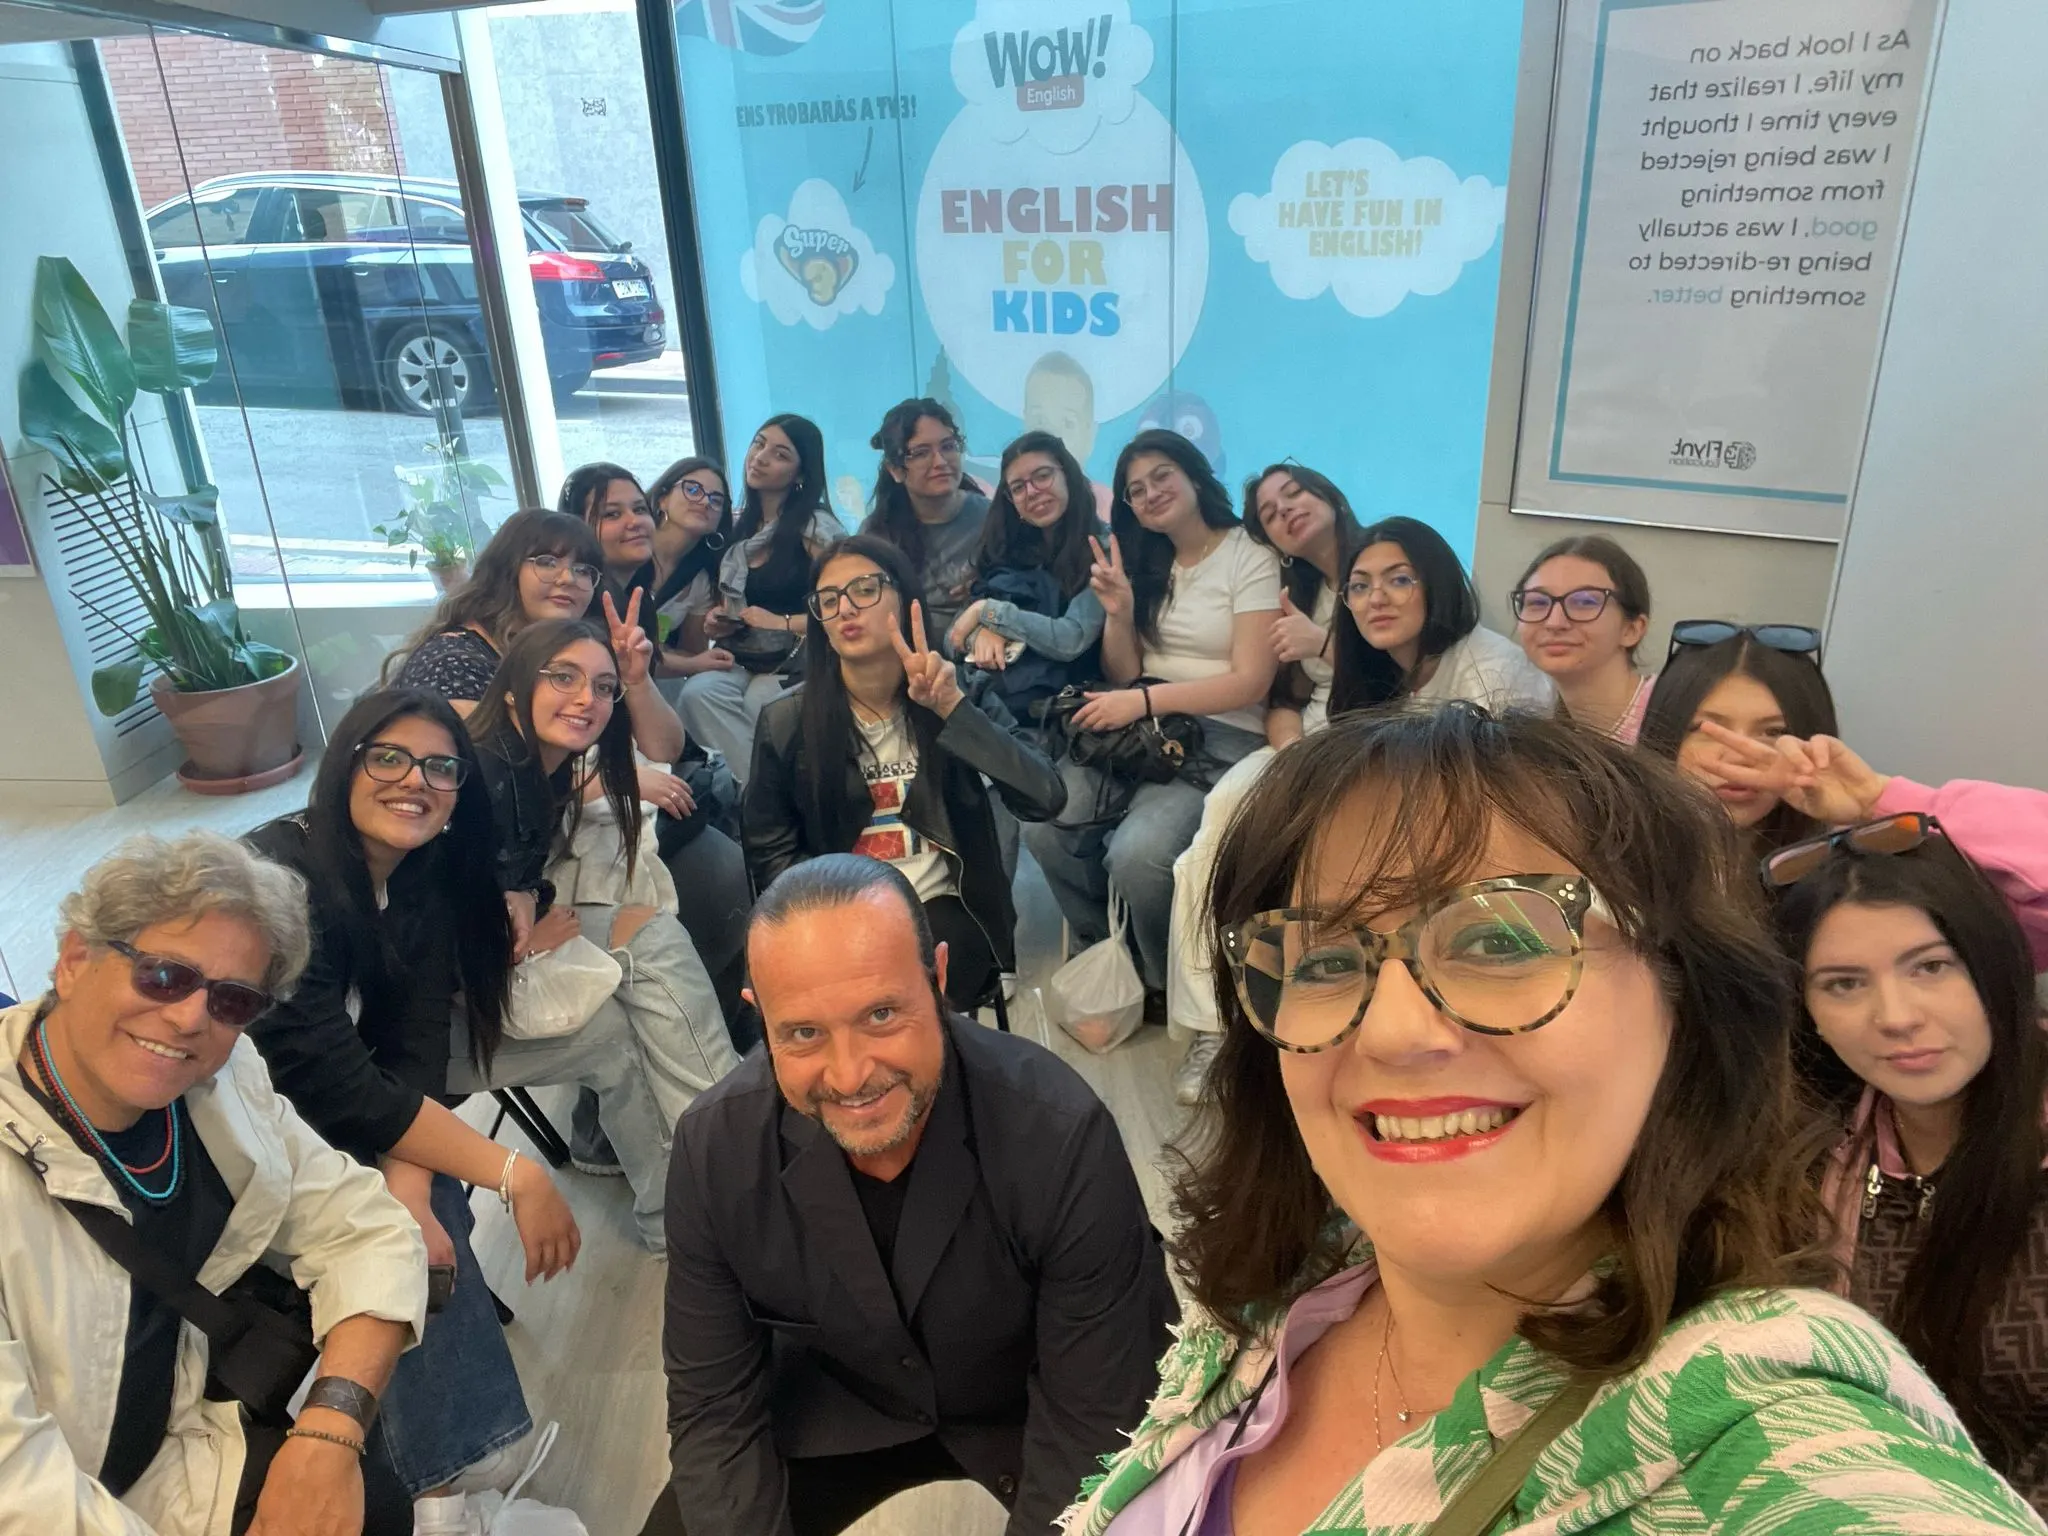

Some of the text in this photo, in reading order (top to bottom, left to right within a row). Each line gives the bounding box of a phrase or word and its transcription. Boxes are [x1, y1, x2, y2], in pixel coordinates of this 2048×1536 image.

[1026, 85, 1077, 106] English
[736, 104, 765, 127] ENS
[860, 97, 874, 121] A
[1305, 169, 1369, 198] LET'S
[941, 184, 1173, 234] ENGLISH
[1279, 198, 1443, 228] HAVE FUN IN
[783, 224, 850, 258] Super
[1308, 229, 1423, 257] ENGLISH!
[1002, 239, 1107, 286] FOR
[804, 260, 837, 303] 3
[992, 290, 1122, 337] KIDS
